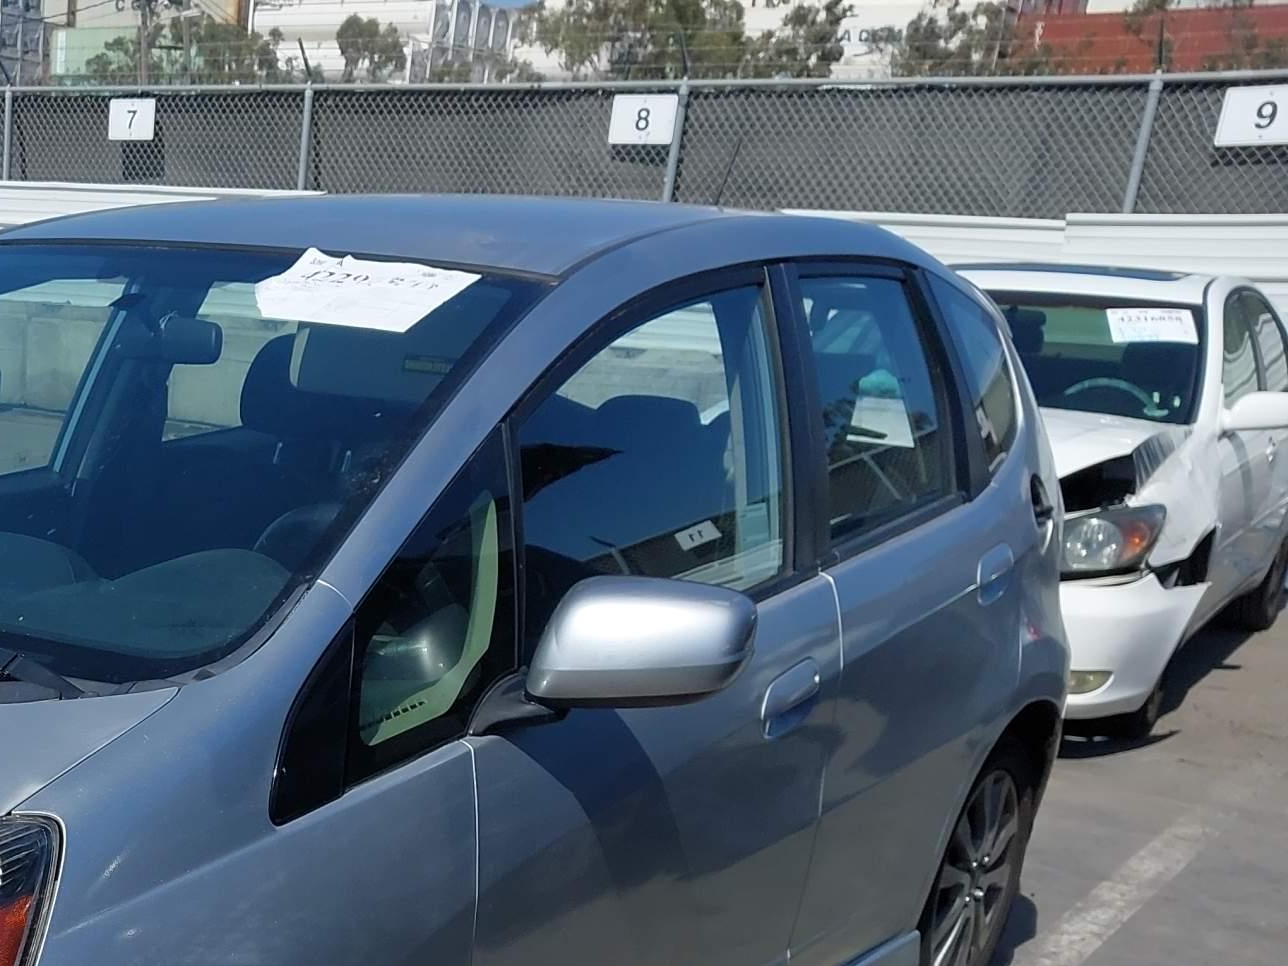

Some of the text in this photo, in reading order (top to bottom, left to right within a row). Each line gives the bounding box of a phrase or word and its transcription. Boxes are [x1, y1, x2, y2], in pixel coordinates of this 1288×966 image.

[127, 109, 139, 130] 7
[635, 107, 651, 132] 8
[1254, 101, 1278, 130] 9
